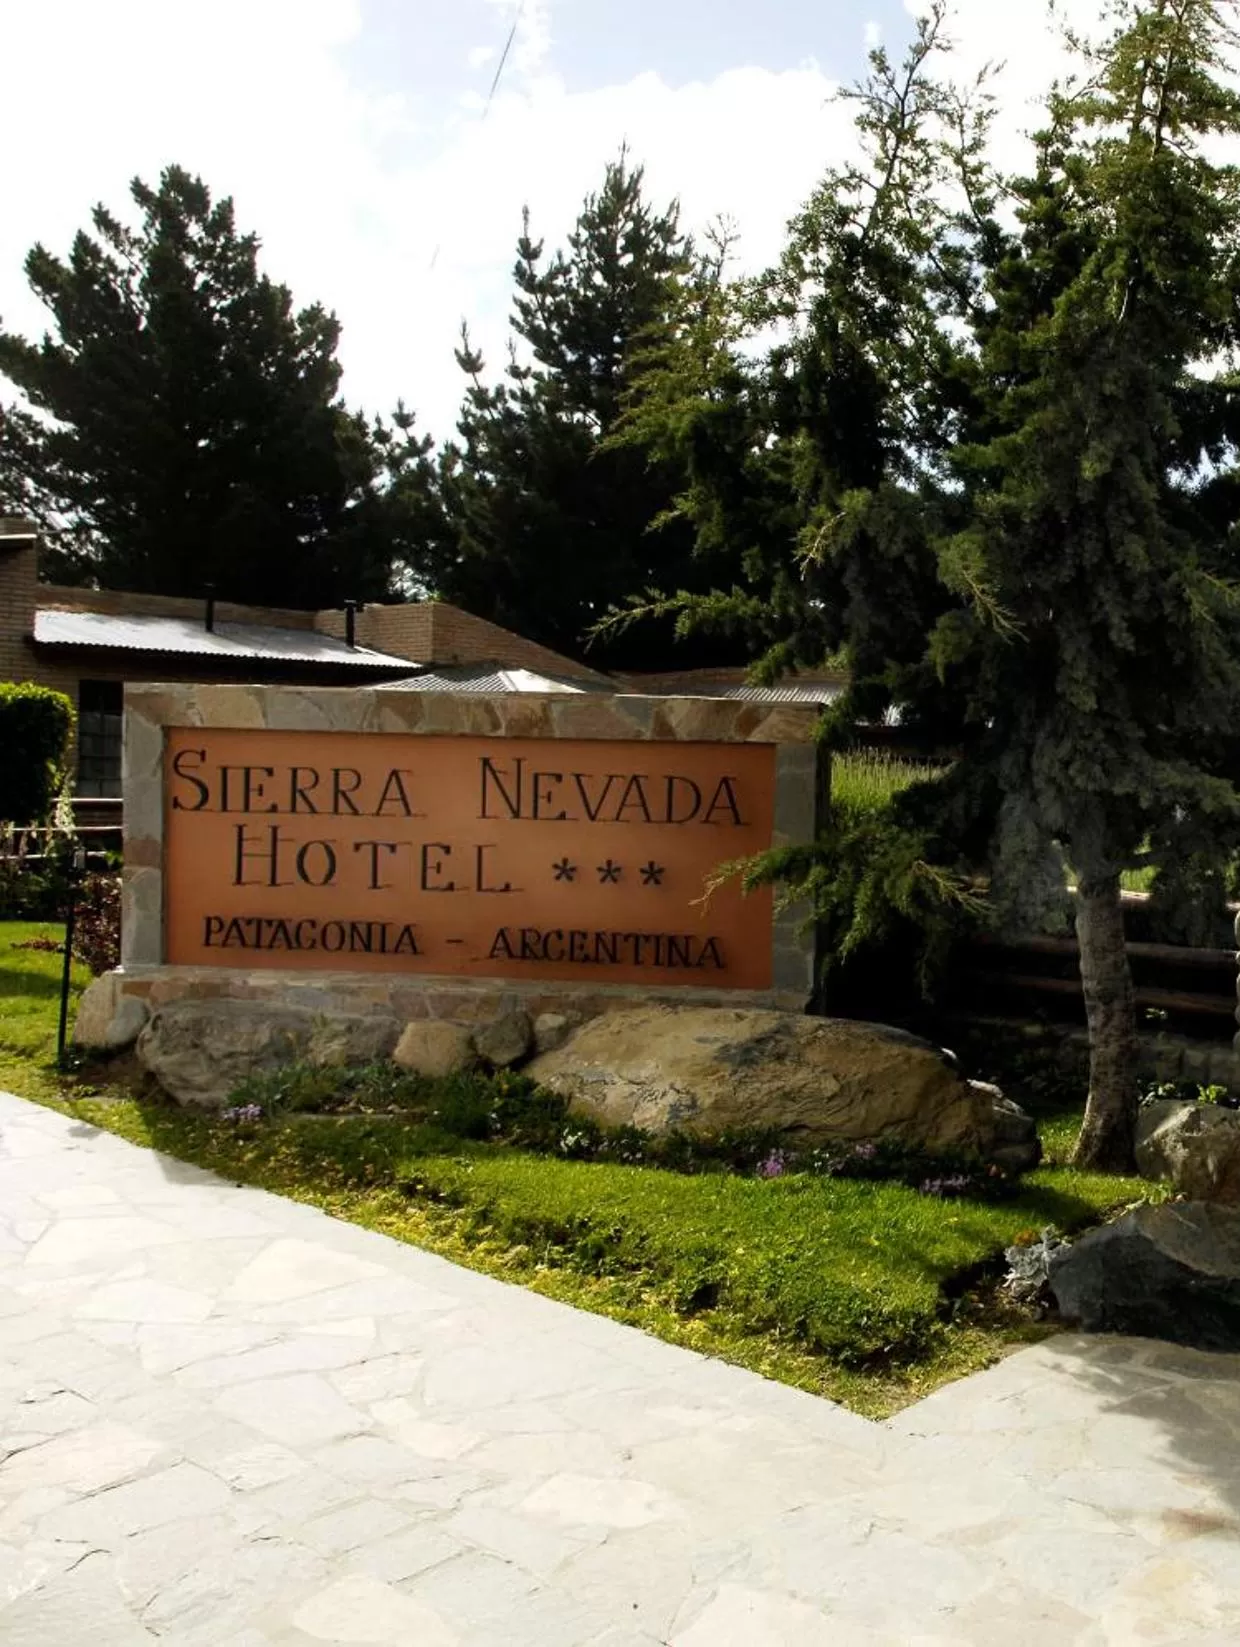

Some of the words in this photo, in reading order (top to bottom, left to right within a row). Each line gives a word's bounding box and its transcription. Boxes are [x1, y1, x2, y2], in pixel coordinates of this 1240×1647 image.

[173, 750, 427, 817] SIERRA
[476, 757, 750, 825] NEVADA
[232, 823, 524, 893] HOTEL
